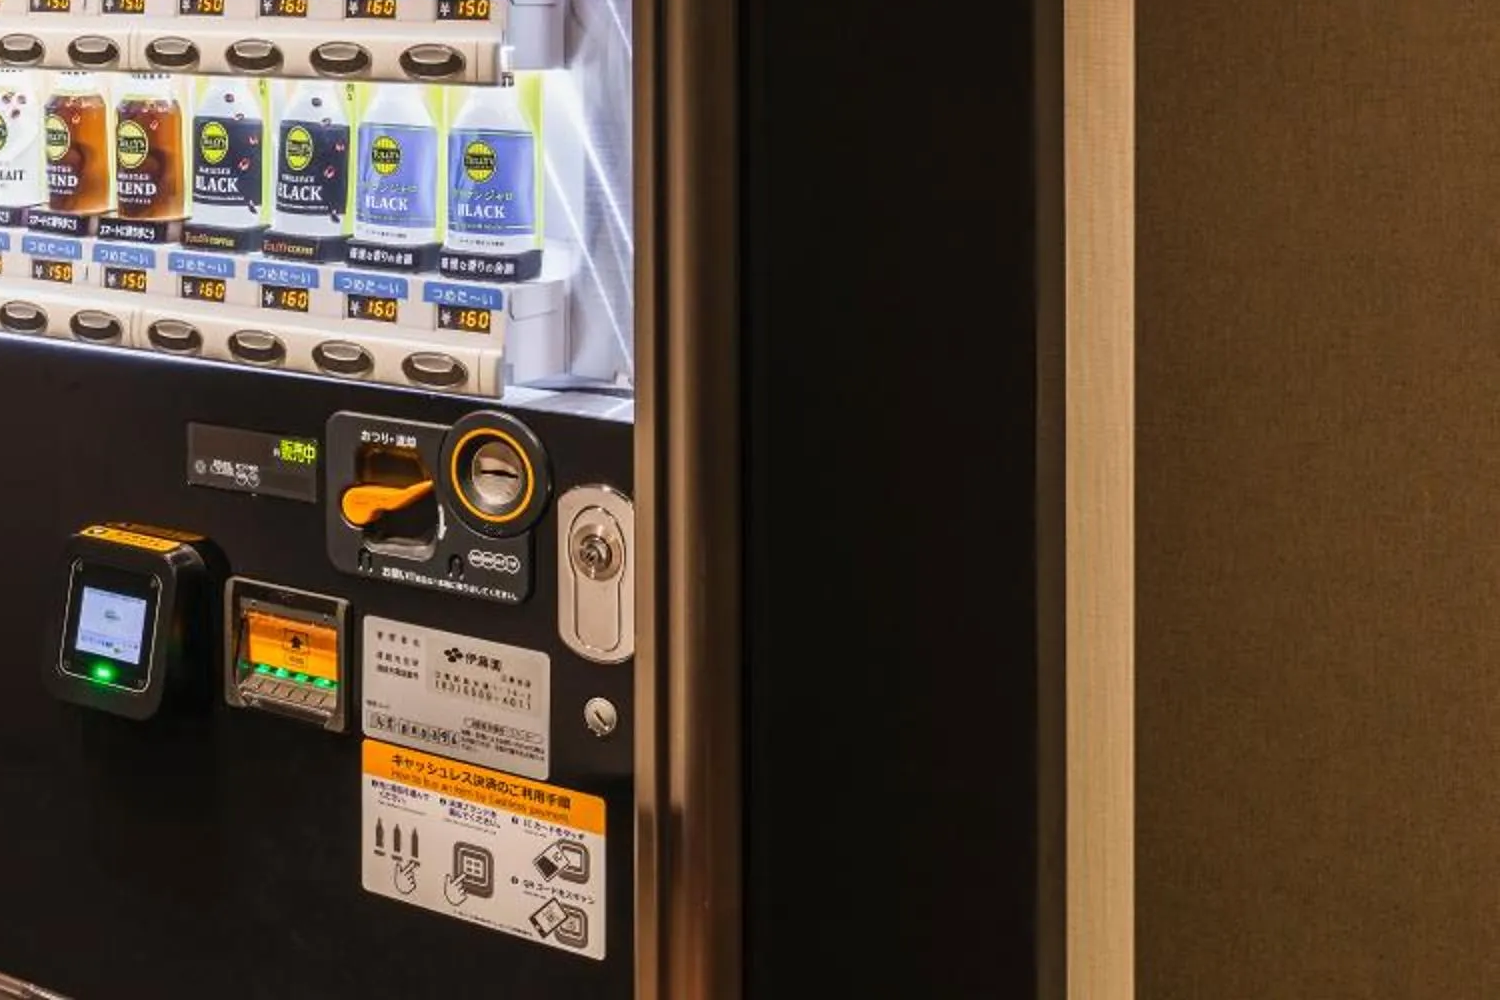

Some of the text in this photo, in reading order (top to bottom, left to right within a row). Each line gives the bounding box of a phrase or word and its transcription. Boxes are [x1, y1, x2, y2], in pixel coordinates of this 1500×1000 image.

[116, 180, 158, 196] LEND
[276, 182, 324, 202] BLACK
[365, 195, 409, 212] BLACK
[456, 203, 507, 219] BLACK
